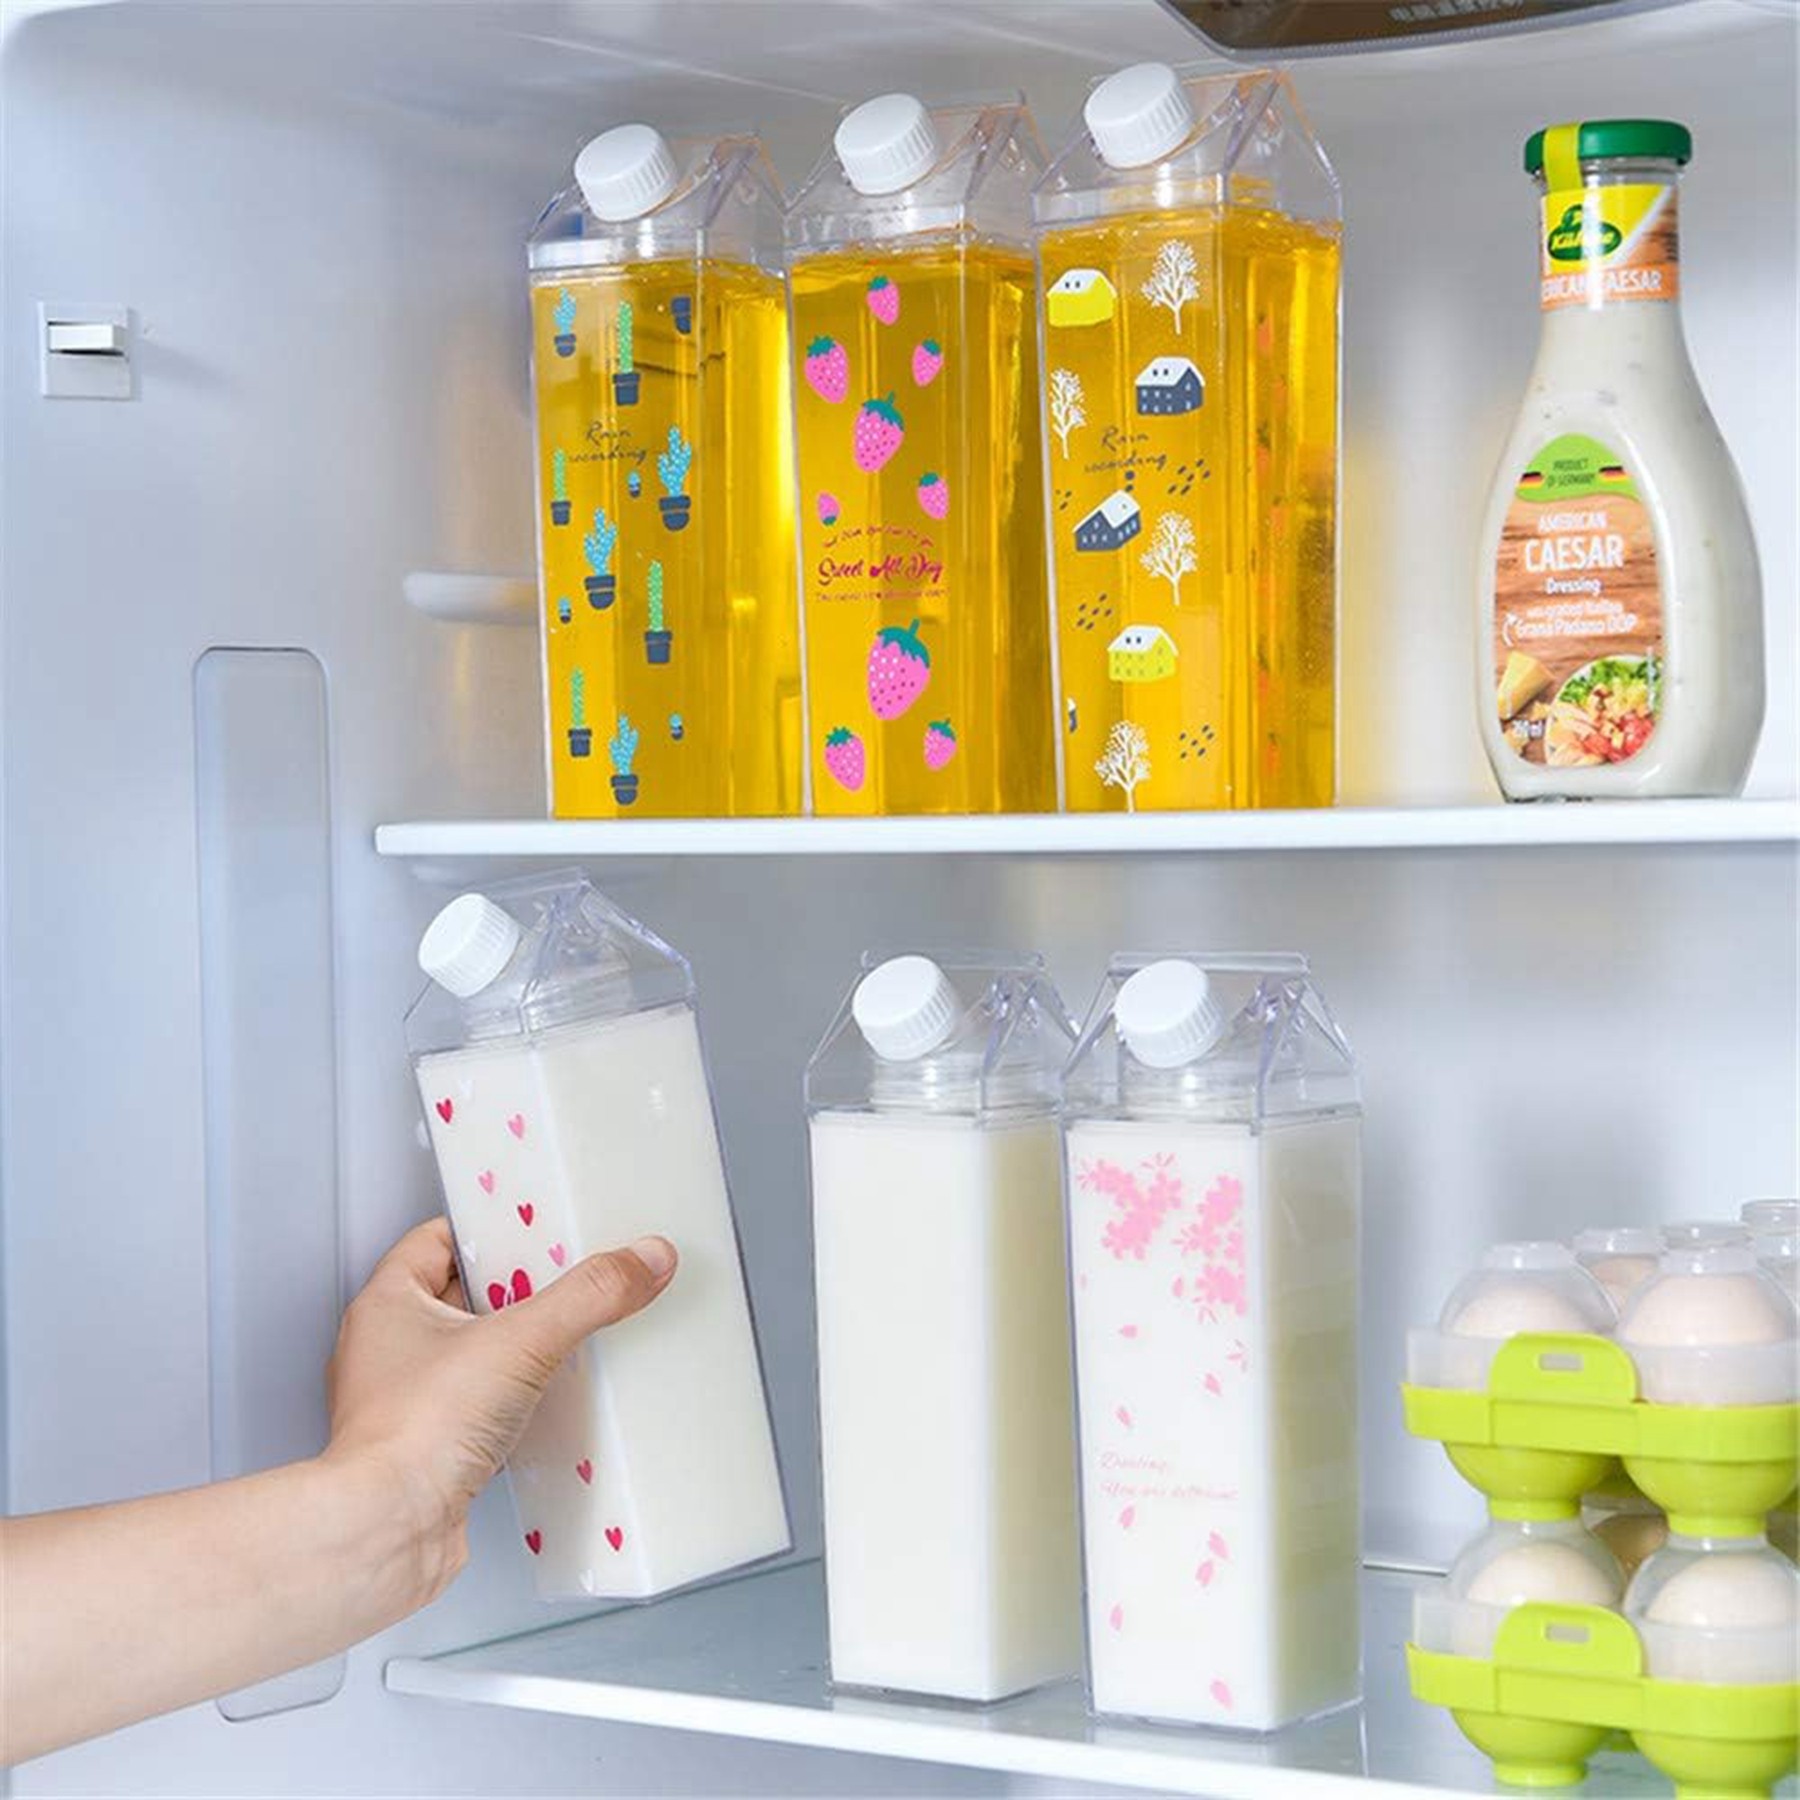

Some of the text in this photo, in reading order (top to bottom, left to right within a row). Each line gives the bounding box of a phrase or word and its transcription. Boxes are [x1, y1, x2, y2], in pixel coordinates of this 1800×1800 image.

[1539, 512, 1606, 532] AMERICAN
[1525, 535, 1624, 572] CAESAR
[1546, 577, 1601, 596] Dressing
